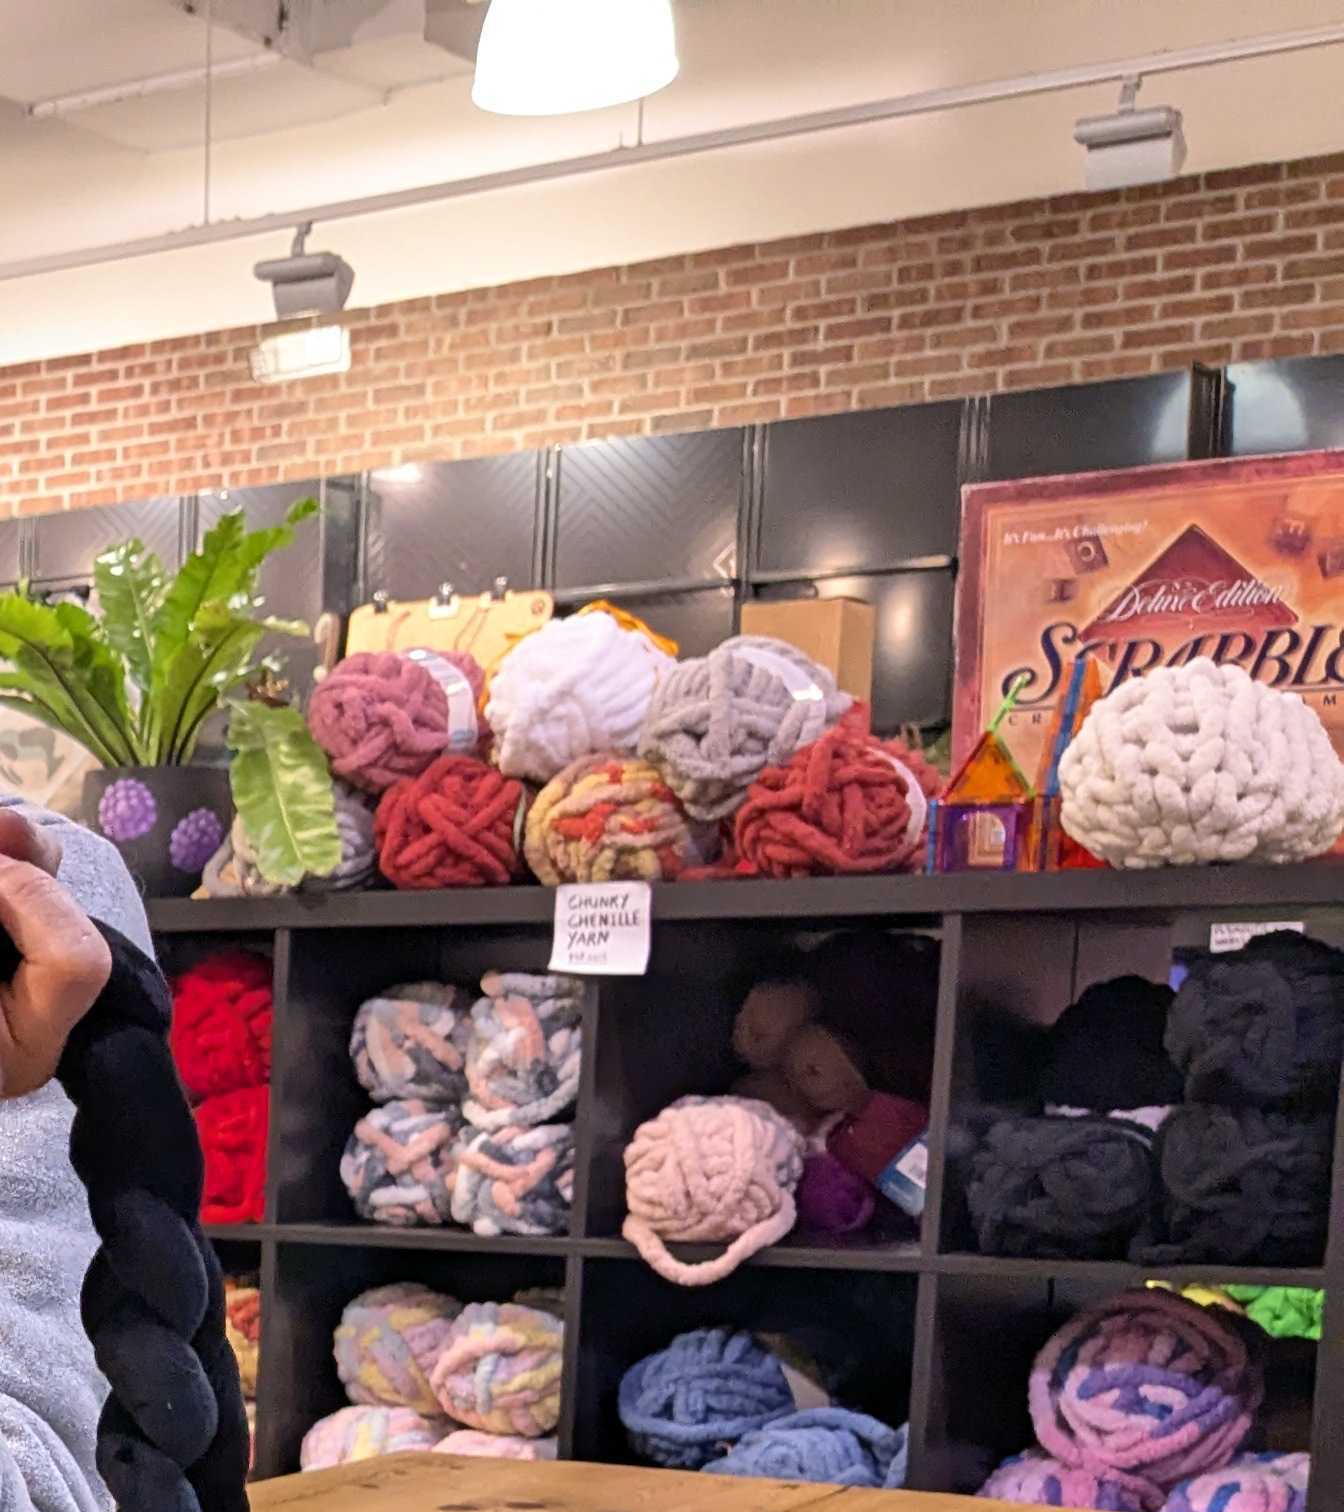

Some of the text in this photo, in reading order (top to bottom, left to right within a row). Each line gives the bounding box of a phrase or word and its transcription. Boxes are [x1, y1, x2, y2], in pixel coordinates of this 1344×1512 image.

[568, 894, 629, 910] CHUNKY
[568, 910, 640, 928] CHENILLE
[568, 931, 610, 950] YARN
